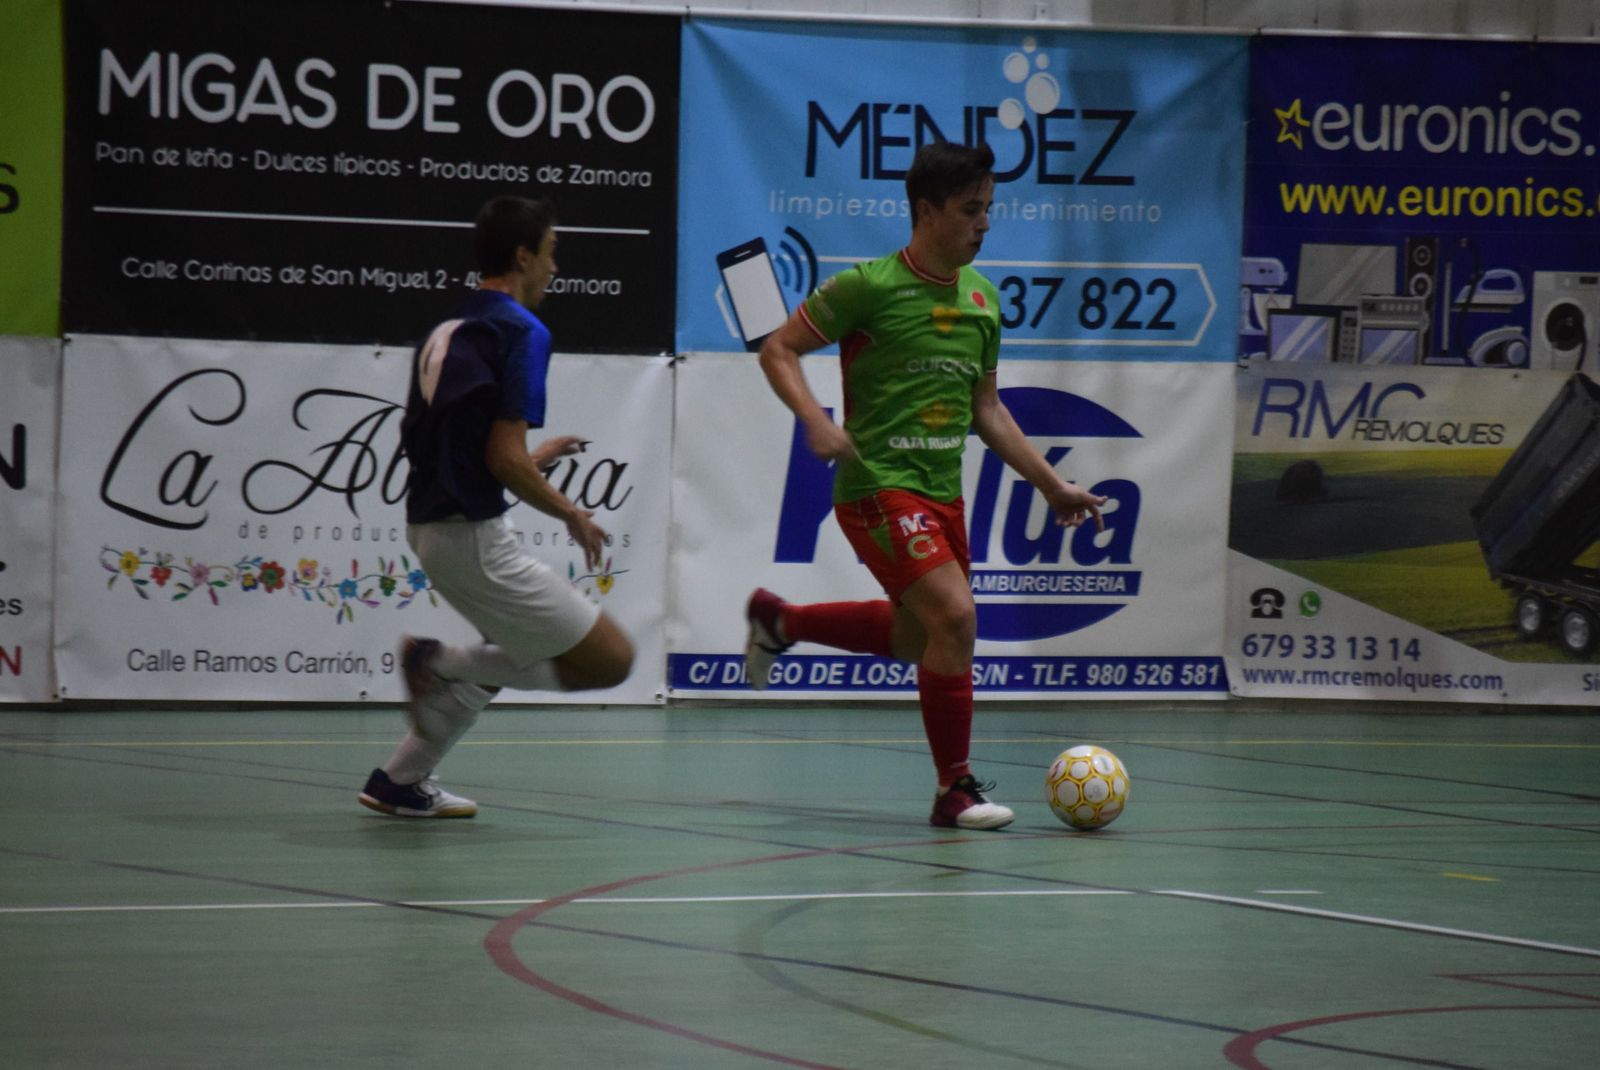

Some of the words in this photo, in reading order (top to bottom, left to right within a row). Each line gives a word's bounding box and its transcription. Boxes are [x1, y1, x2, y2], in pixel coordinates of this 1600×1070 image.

[97, 48, 338, 129] MIGAS
[366, 63, 462, 134] DE
[486, 68, 656, 143] ORO
[96, 142, 144, 164] Pan
[152, 147, 179, 167] de
[185, 147, 233, 168] leña
[254, 150, 327, 173] Dulces
[334, 152, 401, 176] típicos
[419, 157, 529, 182] Productos
[536, 165, 563, 184] de
[568, 164, 653, 187] Zamora
[769, 190, 910, 220] limpiezas
[993, 197, 1161, 223] ntenimiento
[1279, 177, 1600, 217] www.euronics.
[121, 256, 178, 280] Calle
[184, 259, 273, 284] Cortinas
[278, 265, 306, 284] de
[310, 264, 355, 286] San
[435, 269, 447, 289] 2
[1001, 276, 1064, 329] 37
[1078, 277, 1176, 330] 822
[1252, 378, 1426, 438] RMC
[1352, 419, 1505, 445] REMOLQUES
[100, 369, 246, 530] La
[238, 520, 268, 539] de
[293, 523, 399, 544] produc
[968, 575, 1126, 592] AMBURGUESERIA
[127, 648, 186, 672] Calle
[194, 650, 277, 673] Ramos
[285, 650, 373, 677] Carrión,
[381, 652, 394, 674] 9
[1242, 634, 1294, 658] 679
[1303, 635, 1336, 659] 33
[1346, 637, 1378, 661] 13
[1388, 638, 1421, 662] 14
[689, 661, 719, 684] C/
[721, 661, 803, 685] DIGO
[808, 662, 846, 685] DE
[1032, 664, 1077, 686] TLF.
[1086, 664, 1127, 686] 980
[1133, 664, 1173, 686] 526
[1180, 664, 1219, 686] 581
[1242, 667, 1503, 693] www.rmcremolques.com
